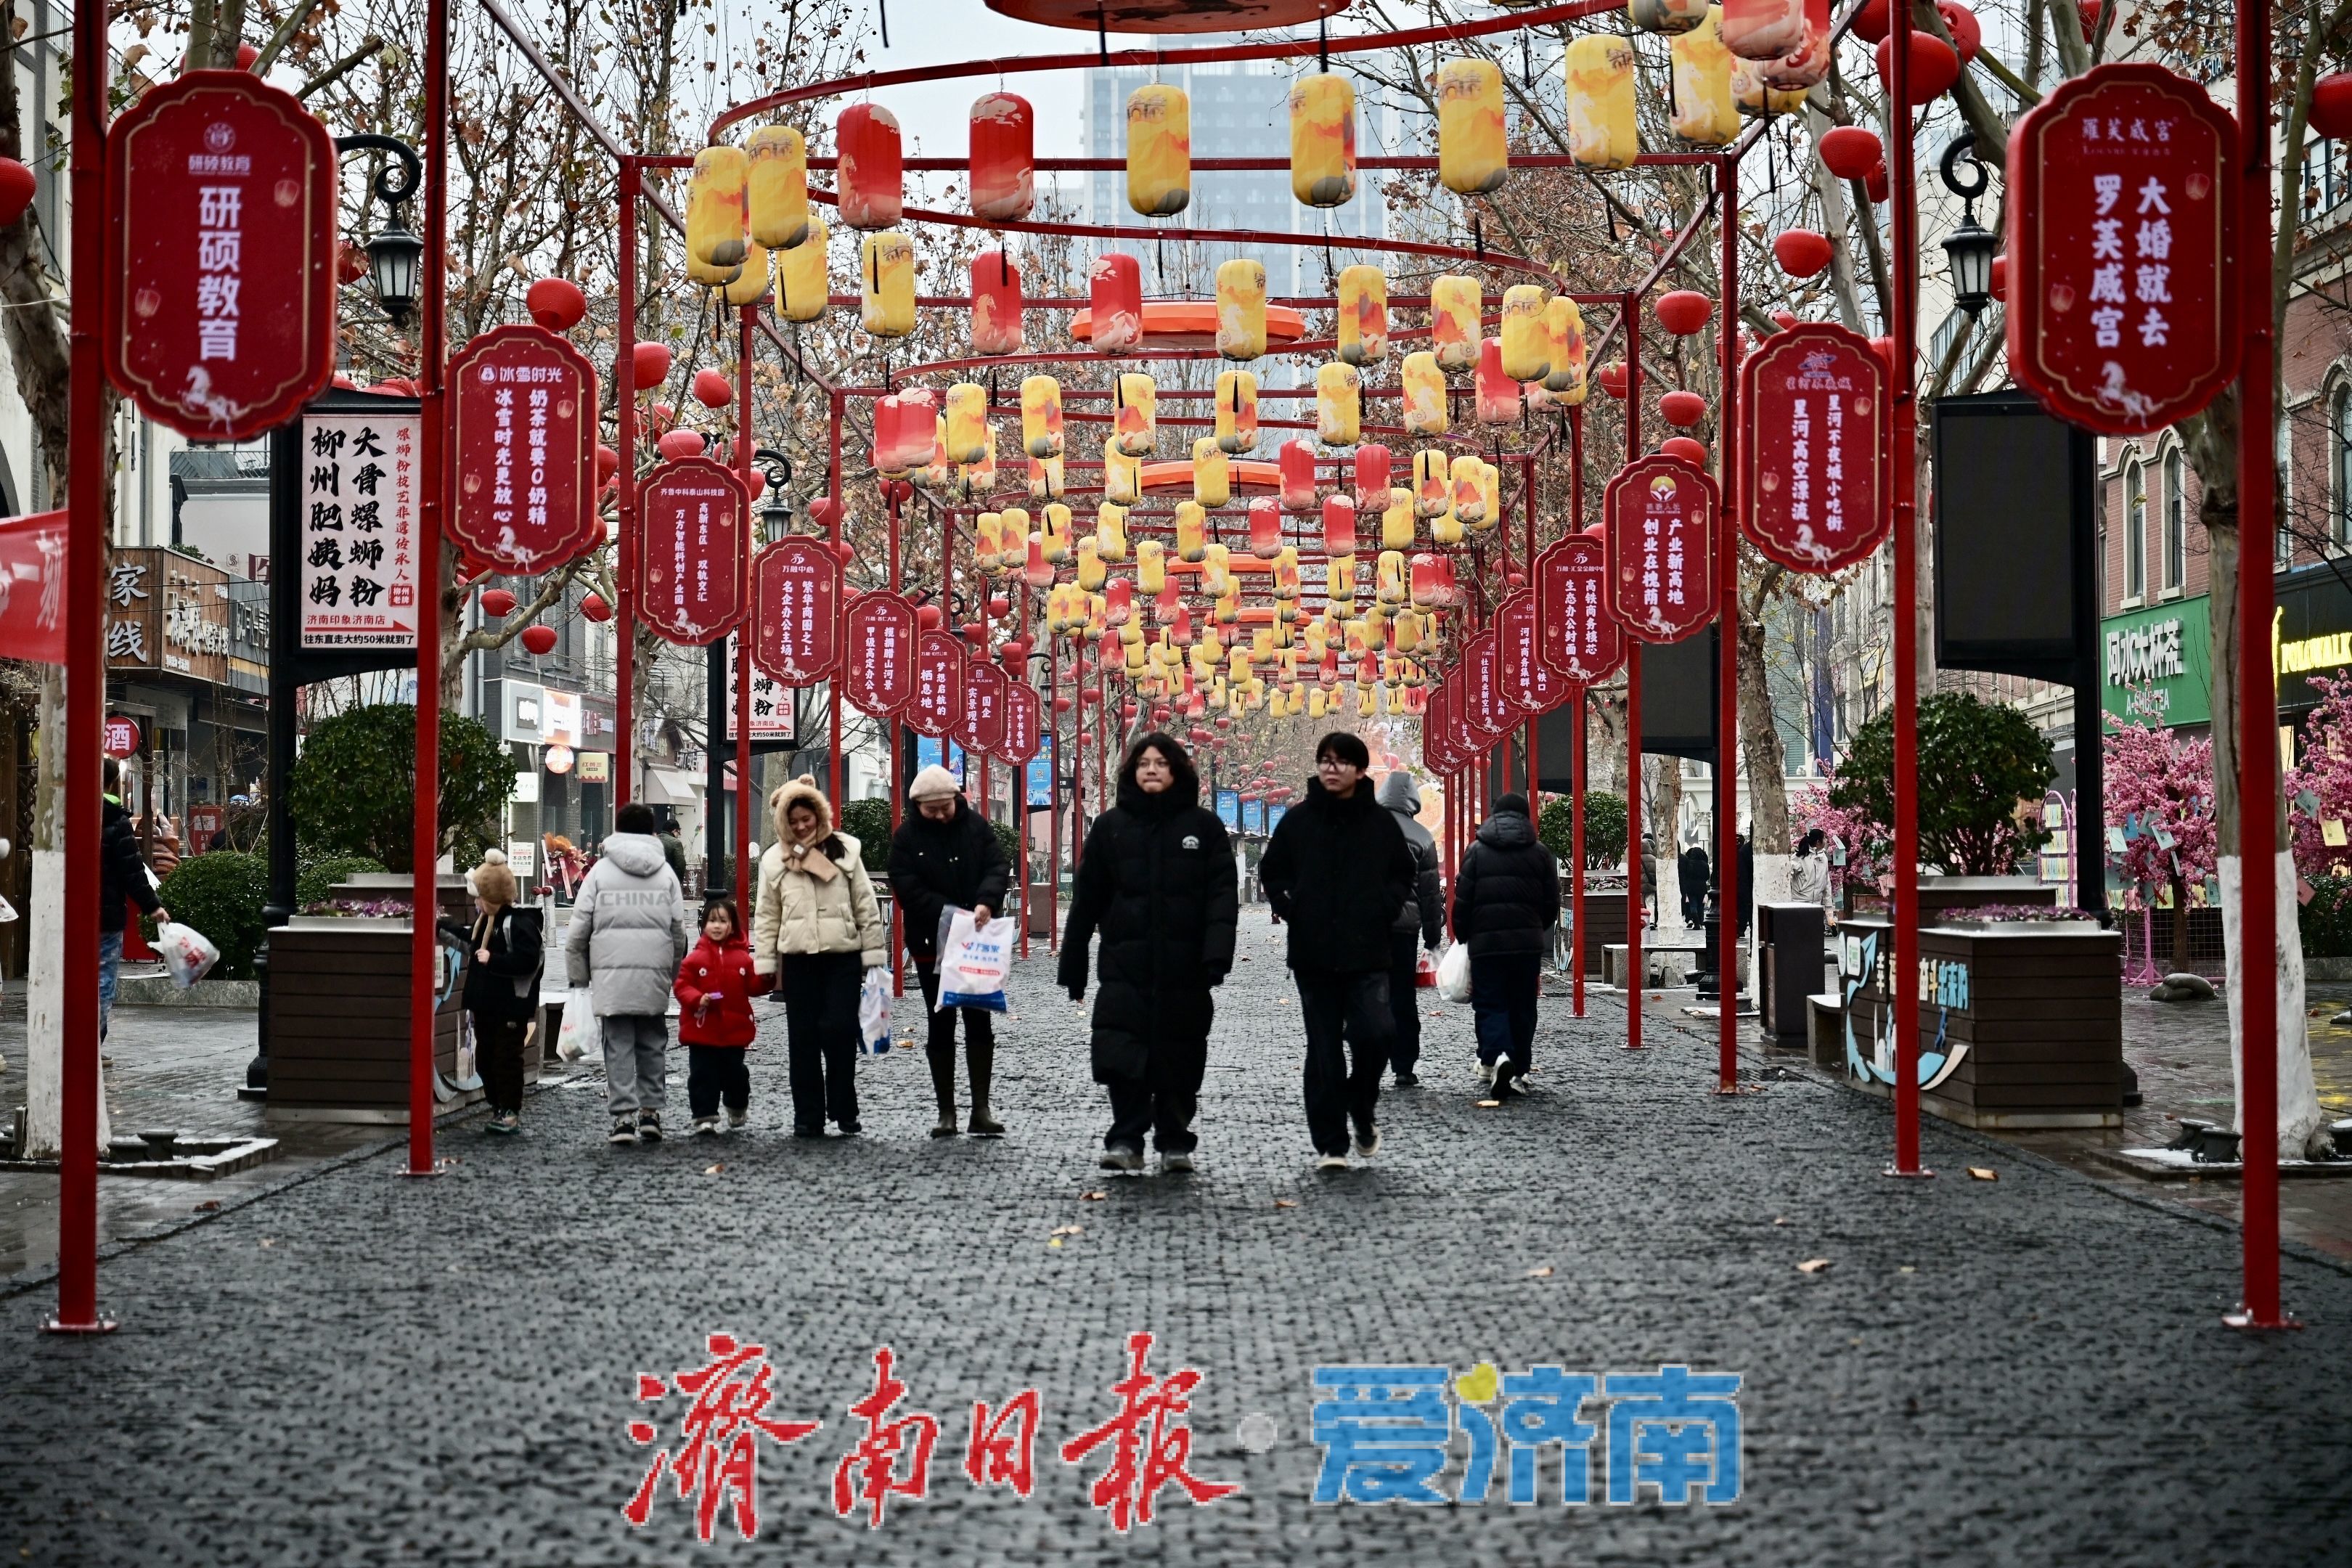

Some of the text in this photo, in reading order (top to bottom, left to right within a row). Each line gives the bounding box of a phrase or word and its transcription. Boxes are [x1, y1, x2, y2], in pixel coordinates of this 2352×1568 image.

[197, 186, 242, 362] 研硕教育
[2089, 174, 2126, 348] 罗芙威宫
[2136, 176, 2173, 348] 大婚就去
[499, 367, 563, 383] 冰雪时光
[493, 388, 513, 523] 冰雪时光更放心
[1792, 399, 1810, 521] 星河高空漂流
[1826, 394, 1844, 532] 星河不夜城小吃街
[308, 426, 347, 608] 柳州肥姨妈
[348, 426, 387, 608] 大骨螺蛳粉
[661, 488, 724, 497] 齐鲁中科泰山科技园
[110, 562, 148, 607] 家
[674, 509, 685, 605] 万方智能科创产业园
[1642, 518, 1660, 605] 创业在槐荫
[1667, 518, 1684, 605] 产业新高地
[108, 620, 147, 663] 线
[304, 634, 415, 645] 往东直走大约50米就到了
[307, 615, 385, 625] 济南印象济南店
[780, 580, 793, 656] 名企办公主场
[801, 580, 814, 656] 繁华商圈之上
[1565, 579, 1577, 656] 生态办公封面
[1585, 579, 1598, 655] 高铁商务核芯
[2107, 618, 2183, 686] 阿水大杯茶
[865, 626, 875, 690] 甲级高定办公
[920, 669, 933, 709] 栖息地
[936, 661, 947, 716] 梦想启航的
[1520, 627, 1530, 687] 河畔商务集群
[104, 724, 130, 751] 酒
[967, 687, 978, 733] 实景现房
[981, 695, 992, 719] 国企
[599, 892, 672, 907] CHINA
